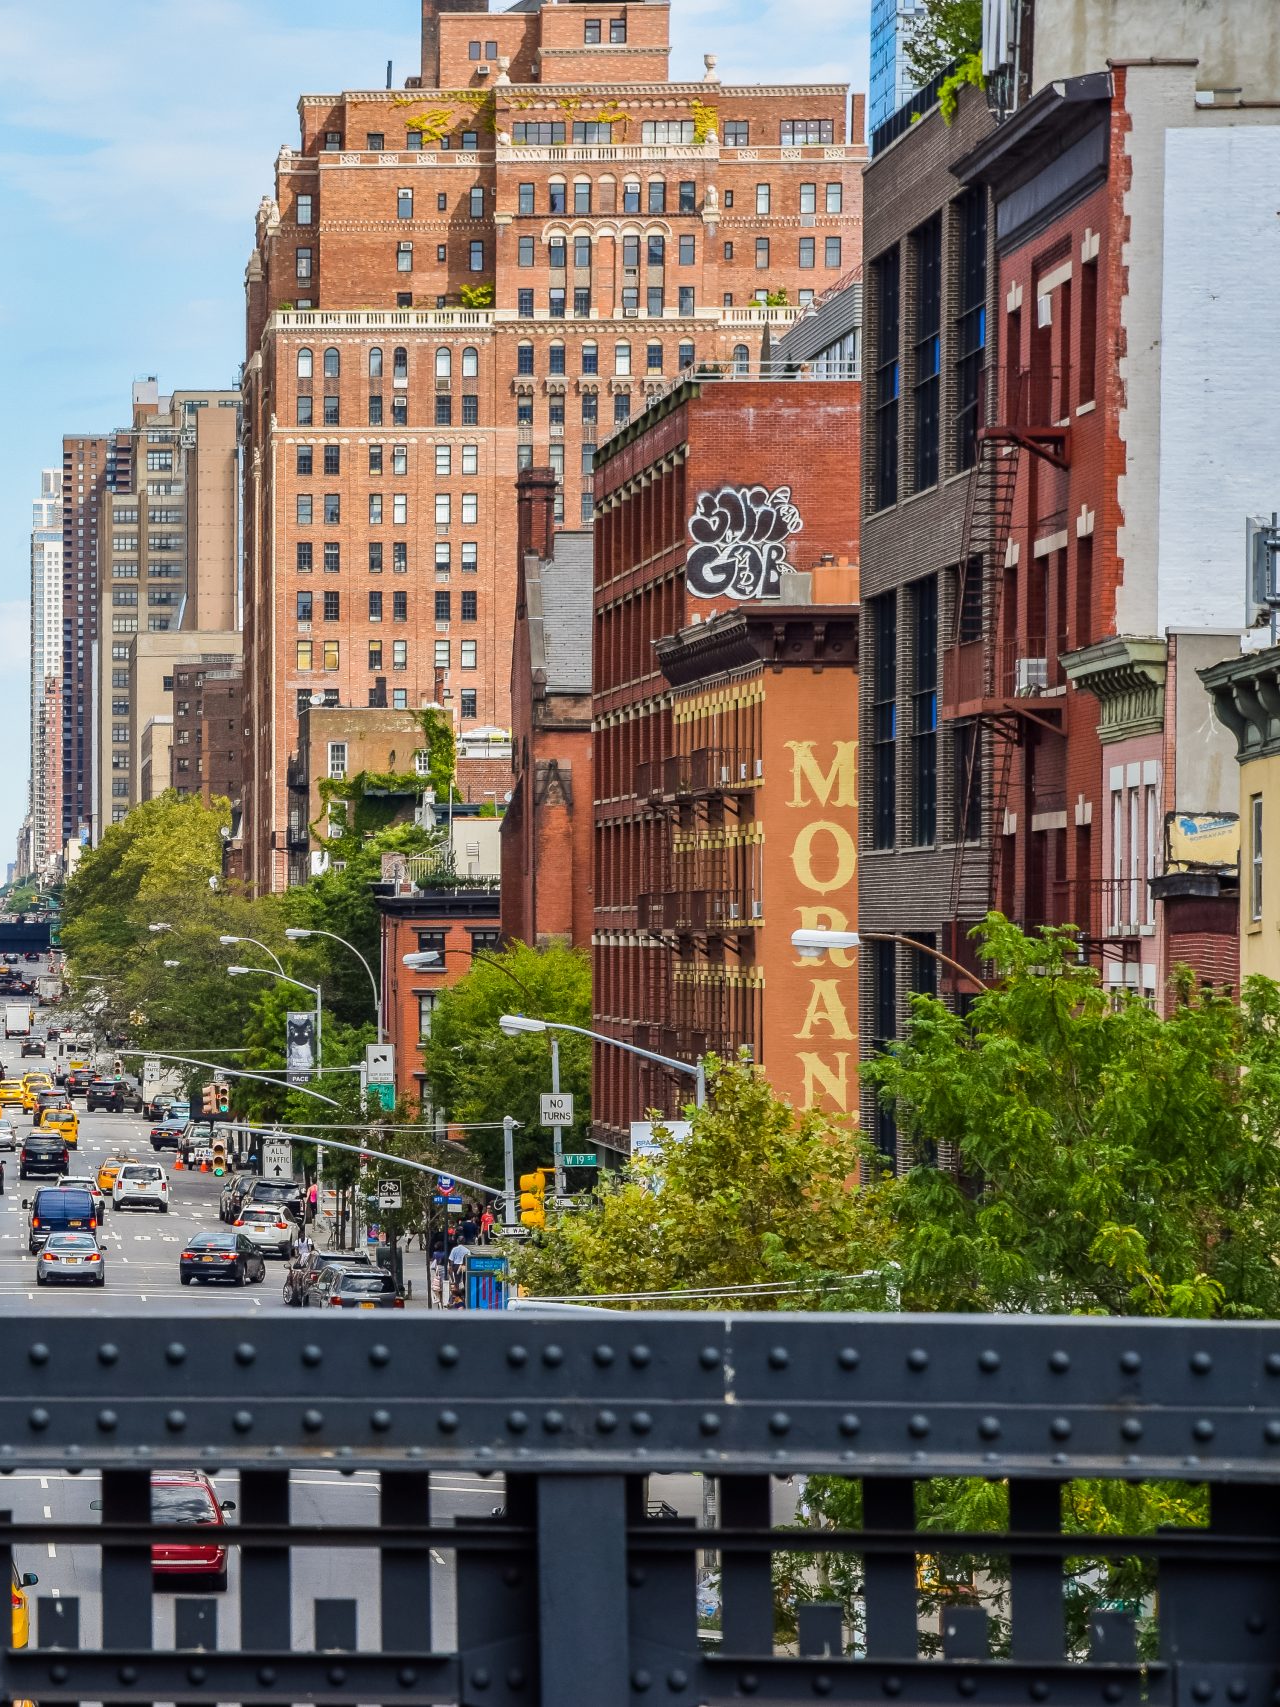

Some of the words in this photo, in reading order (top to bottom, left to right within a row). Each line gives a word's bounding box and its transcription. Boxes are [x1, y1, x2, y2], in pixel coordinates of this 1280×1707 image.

[550, 1099, 564, 1108] NO
[543, 1112, 571, 1120] TURNS
[566, 1156, 573, 1165] W
[576, 1156, 585, 1165] 19
